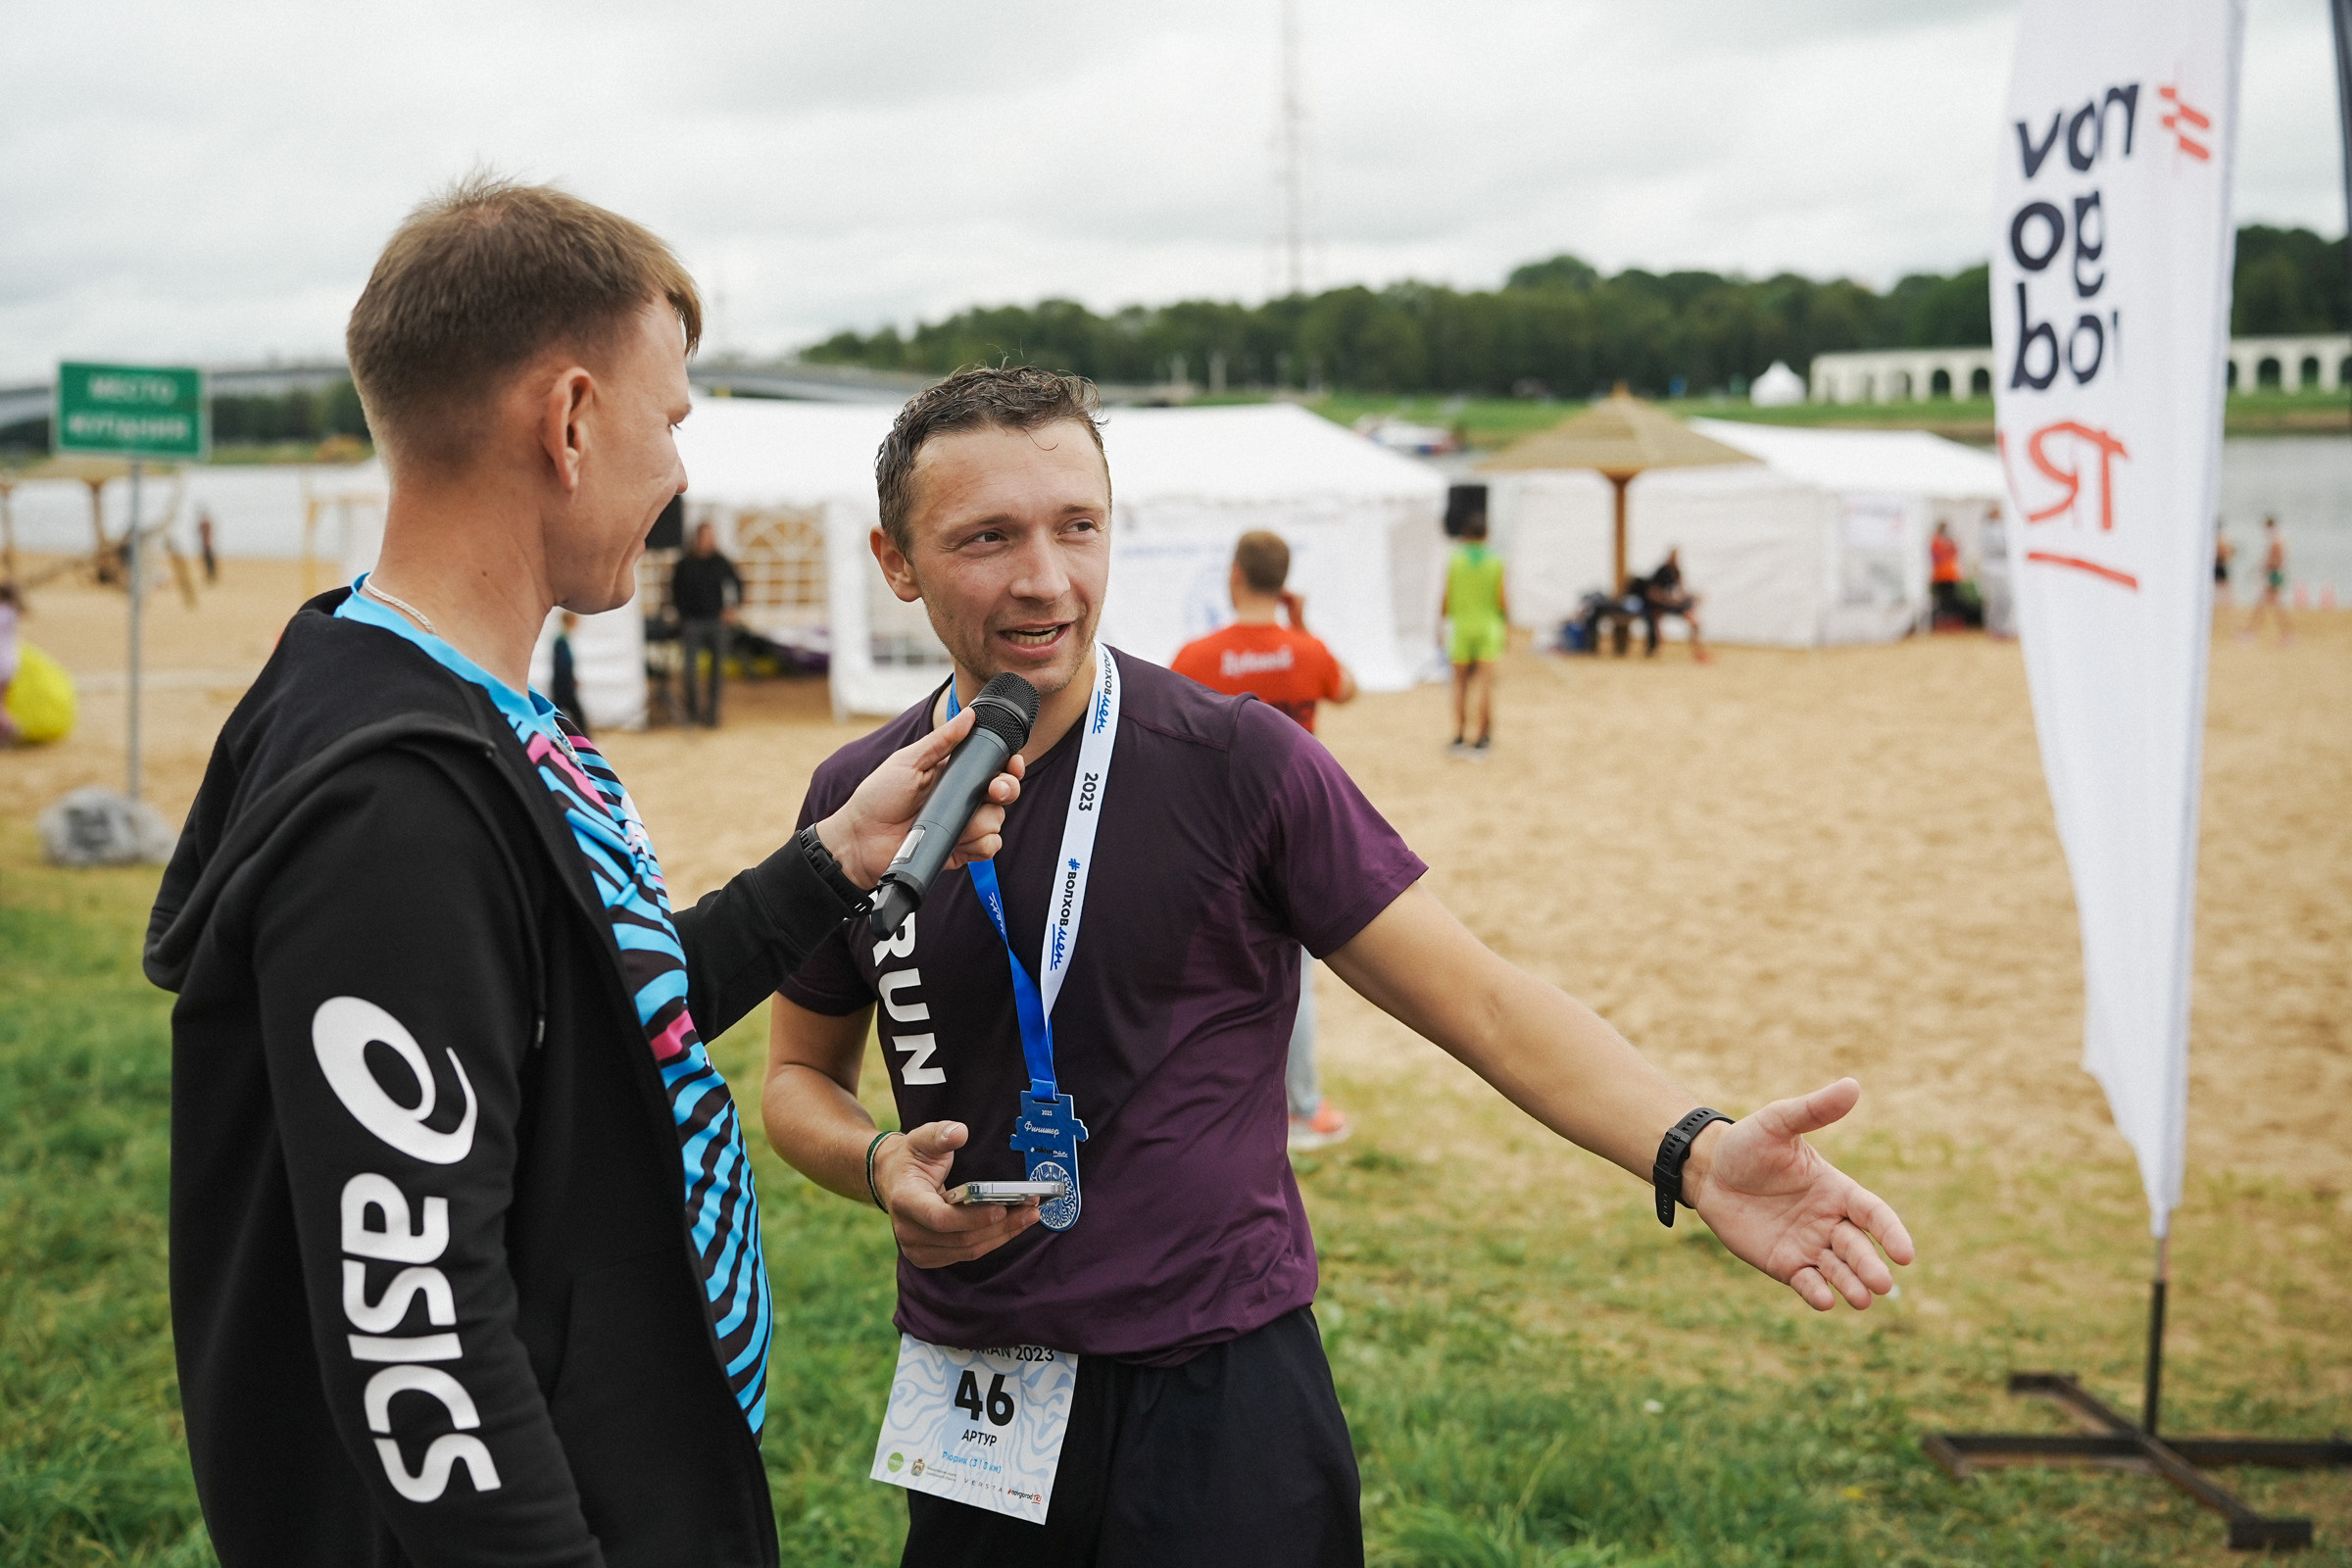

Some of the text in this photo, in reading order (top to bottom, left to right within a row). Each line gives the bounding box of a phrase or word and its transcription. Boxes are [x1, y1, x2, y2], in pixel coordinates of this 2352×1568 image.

[1078, 772, 1099, 811] 2023
[872, 911, 947, 1085] RUN
[1015, 1346, 1054, 1362] 2023
[954, 1369, 1015, 1427] 46
[961, 1429, 998, 1446] АРТУР
